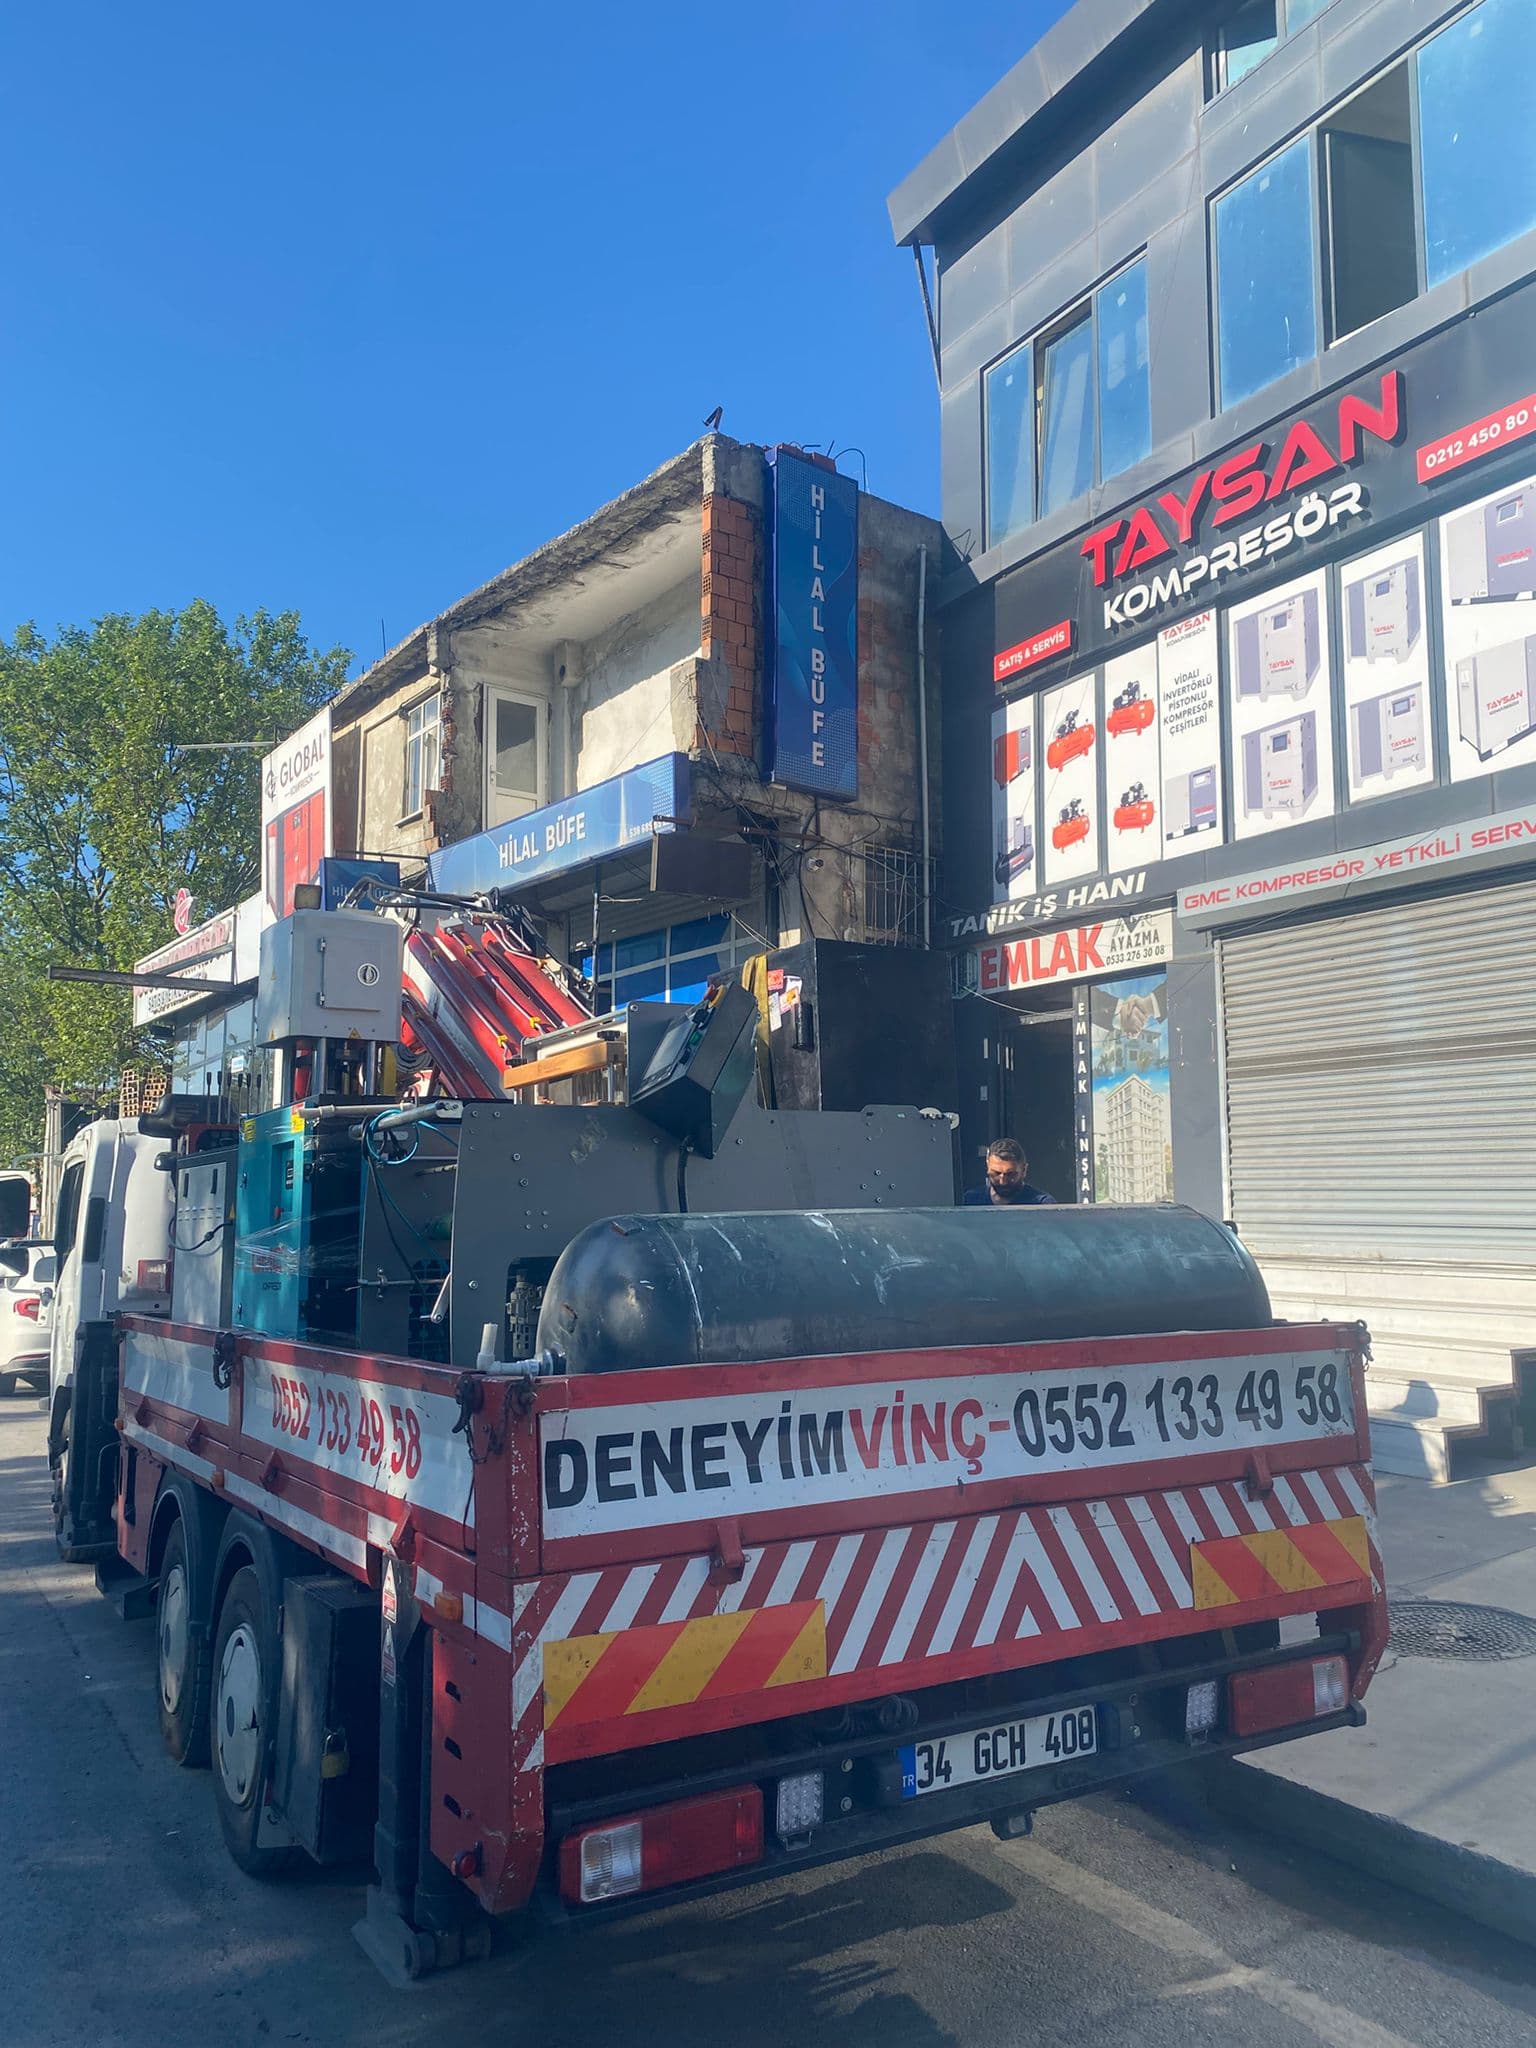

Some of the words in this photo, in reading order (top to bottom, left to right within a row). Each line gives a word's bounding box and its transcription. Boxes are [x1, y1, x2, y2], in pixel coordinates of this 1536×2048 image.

[1425, 441, 1463, 468] 0212
[1468, 423, 1501, 447] 450
[1505, 409, 1529, 431] 80
[1080, 370, 1400, 586] TAYSAN
[811, 484, 824, 632] HİLAL
[1104, 482, 1364, 630] KOMPRESÖR
[998, 651, 1022, 671] SATIŞ
[1032, 630, 1065, 655] SERVİS
[1162, 612, 1211, 641] TAYSAN
[811, 648, 824, 766] BÜFE
[1163, 699, 1214, 726] KOMPRESÖR
[1168, 689, 1207, 712] PİSTONLU
[1169, 711, 1207, 736] ÇEŞİTLERİ
[280, 733, 324, 788] GLOBAL
[499, 833, 540, 869] HİLAL
[545, 811, 586, 852] BÜFE
[1066, 871, 1147, 909] HANI
[1184, 888, 1230, 910] GMC
[1236, 859, 1366, 898] KOMPRESÖR
[1373, 833, 1461, 871] YETKİLİ
[981, 924, 1106, 990] EMLAK
[1106, 953, 1124, 966] 0533
[1127, 950, 1141, 961] 276
[1143, 947, 1153, 958] 30
[1155, 945, 1165, 956] 08
[1110, 929, 1160, 952] AYAZMA
[1075, 1002, 1087, 1093] EMLAK
[271, 1374, 311, 1441] 0552
[317, 1386, 351, 1455] 133
[357, 1397, 385, 1466] 49
[390, 1404, 422, 1479] 58
[1145, 1373, 1224, 1442] 133
[1235, 1368, 1284, 1440] 49
[1295, 1363, 1343, 1426] 58
[916, 1741, 952, 1789] 34
[974, 1724, 1026, 1775] GCH
[1045, 1710, 1094, 1758] 408
[902, 1775, 914, 1788] TR
